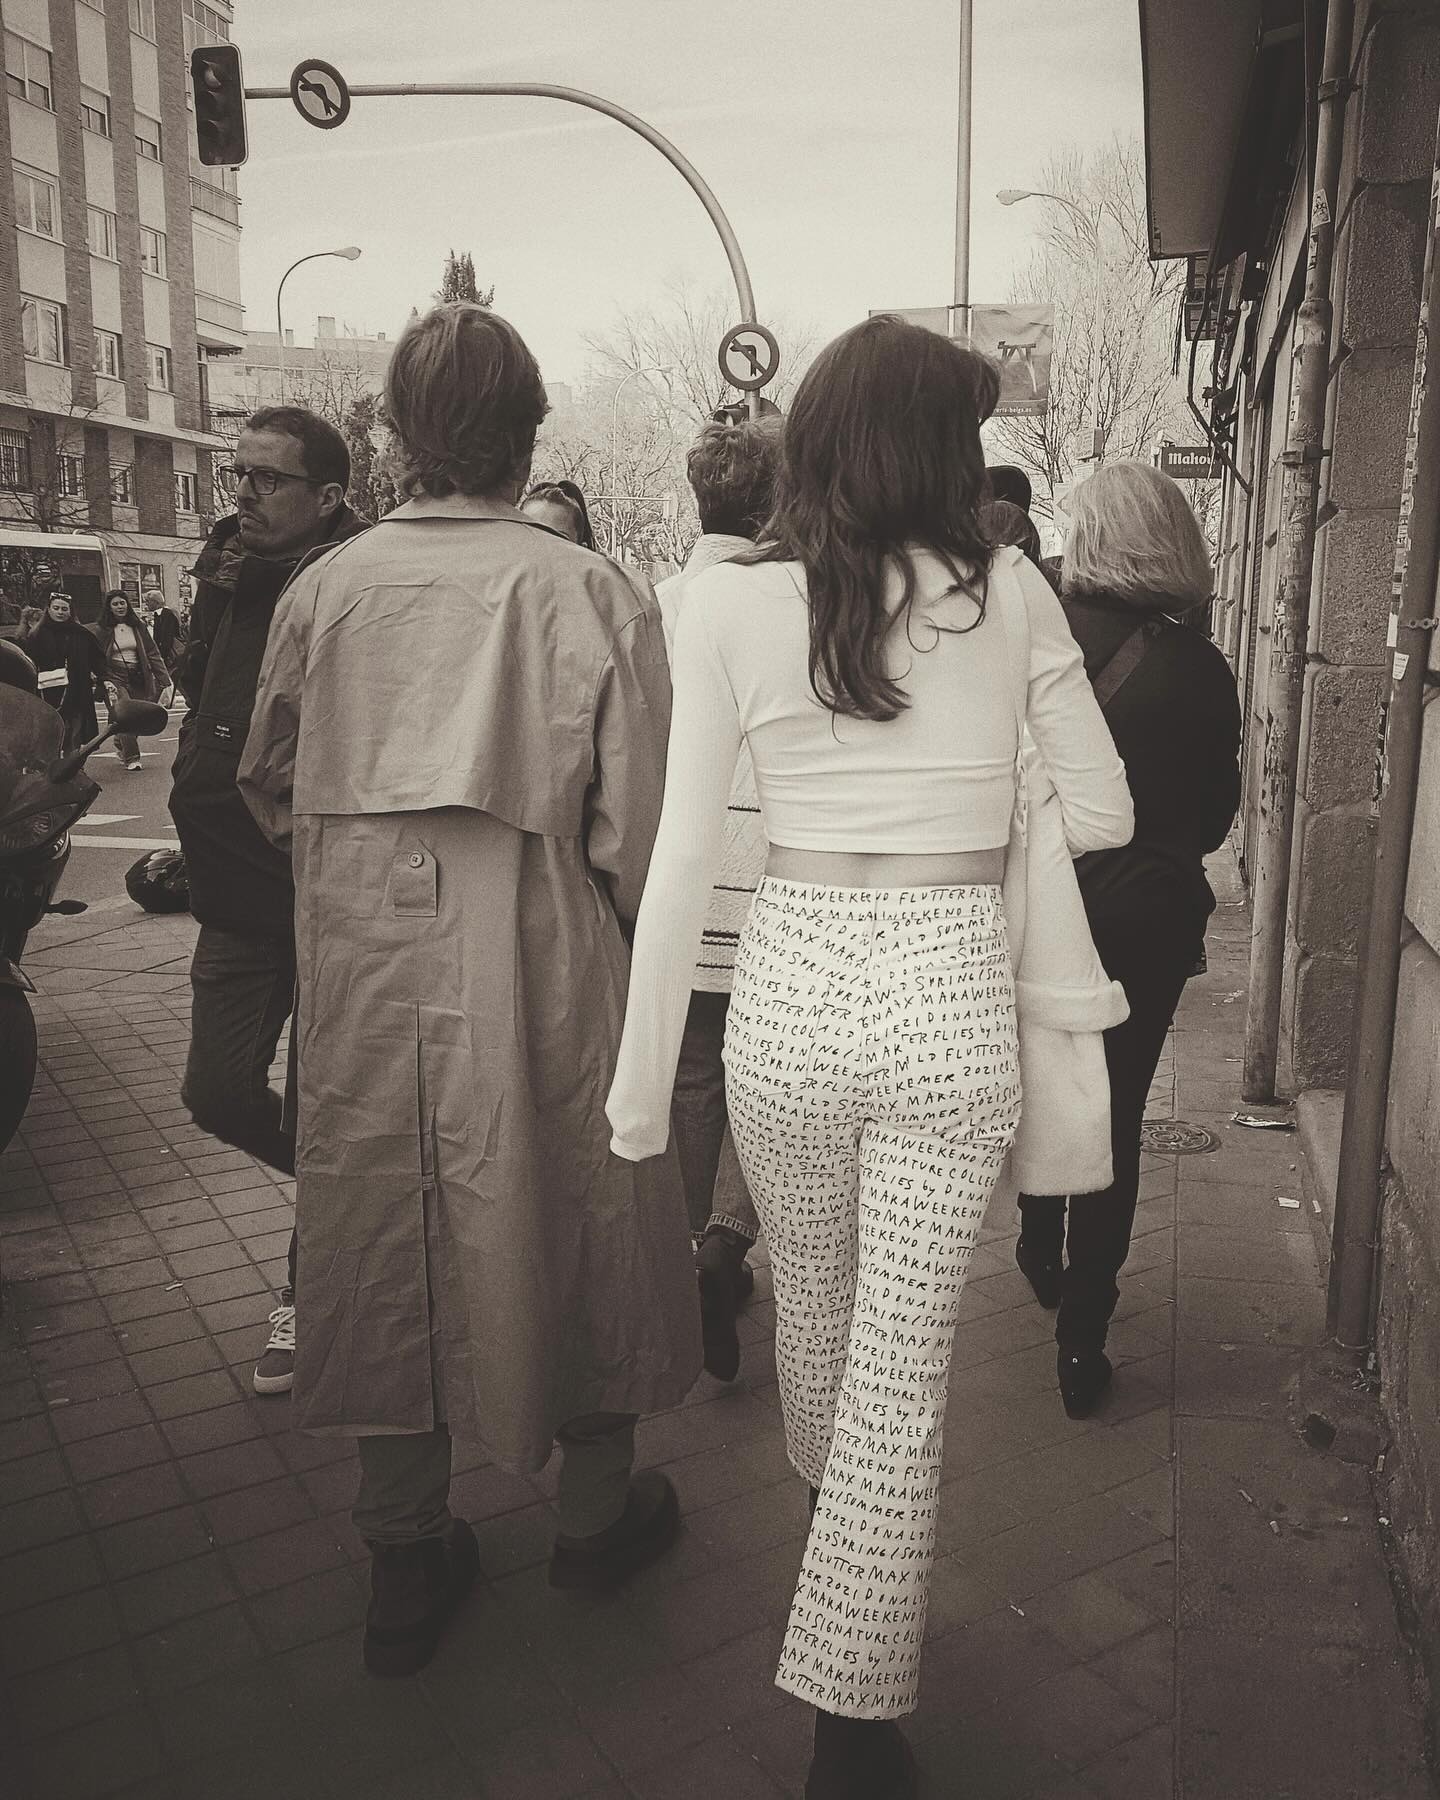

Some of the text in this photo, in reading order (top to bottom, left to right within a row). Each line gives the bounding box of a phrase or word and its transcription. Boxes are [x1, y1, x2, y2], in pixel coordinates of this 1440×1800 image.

[788, 981, 800, 998] by
[927, 1008, 990, 1023] DONALD
[946, 1044, 1001, 1062] FLUTTER
[867, 1148, 944, 1177] SIGNATURE
[922, 1179, 936, 1198] by
[883, 1209, 926, 1231] MAX
[883, 1287, 947, 1312] DONALD
[890, 1329, 931, 1349] MAX
[896, 1404, 909, 1423] by
[862, 1436, 902, 1458] MAX
[825, 1463, 856, 1487] MAX
[860, 1519, 925, 1541] DONALD
[812, 1546, 911, 1586] FLUTTER MAX
[826, 1576, 858, 1600] 2021
[811, 1612, 888, 1645] SIGNATURE
[868, 1649, 880, 1669] by
[826, 1685, 870, 1708] MAX
